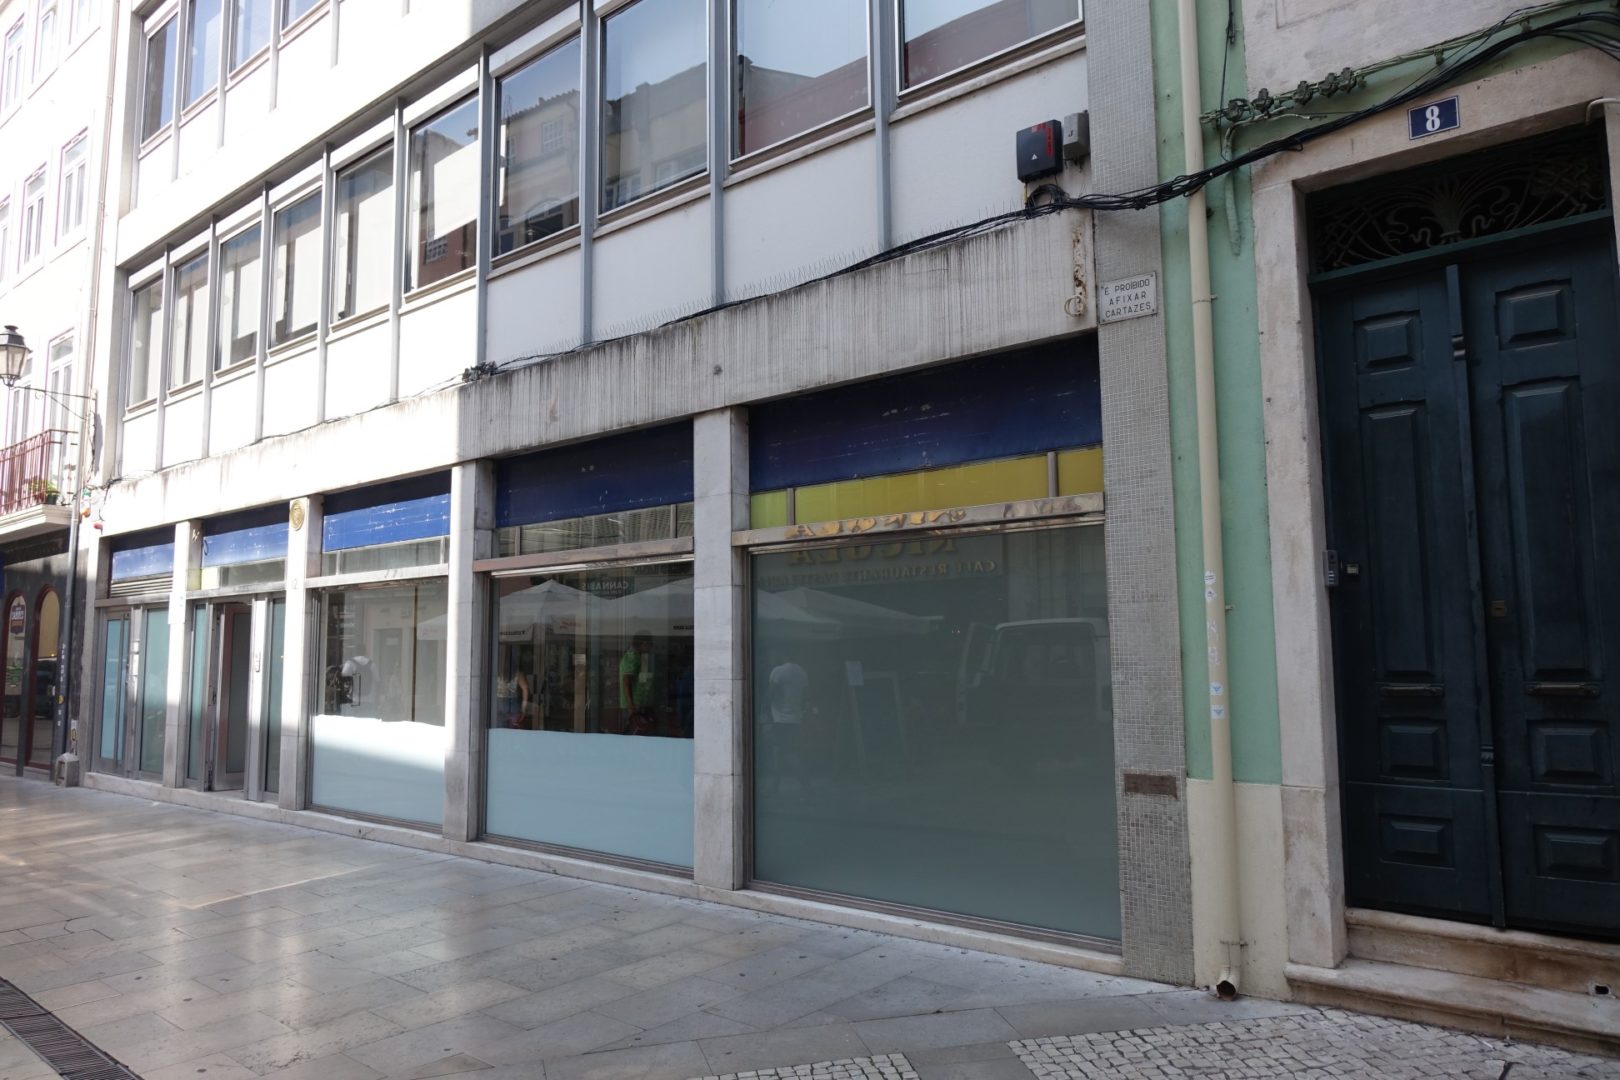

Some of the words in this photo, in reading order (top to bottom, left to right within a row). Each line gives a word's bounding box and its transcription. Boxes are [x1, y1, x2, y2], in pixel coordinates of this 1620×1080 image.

[1425, 105, 1440, 131] 8
[1115, 279, 1150, 292] PROIBIDO
[1109, 291, 1147, 306] AFIXAR
[1105, 301, 1151, 318] CARTAZES
